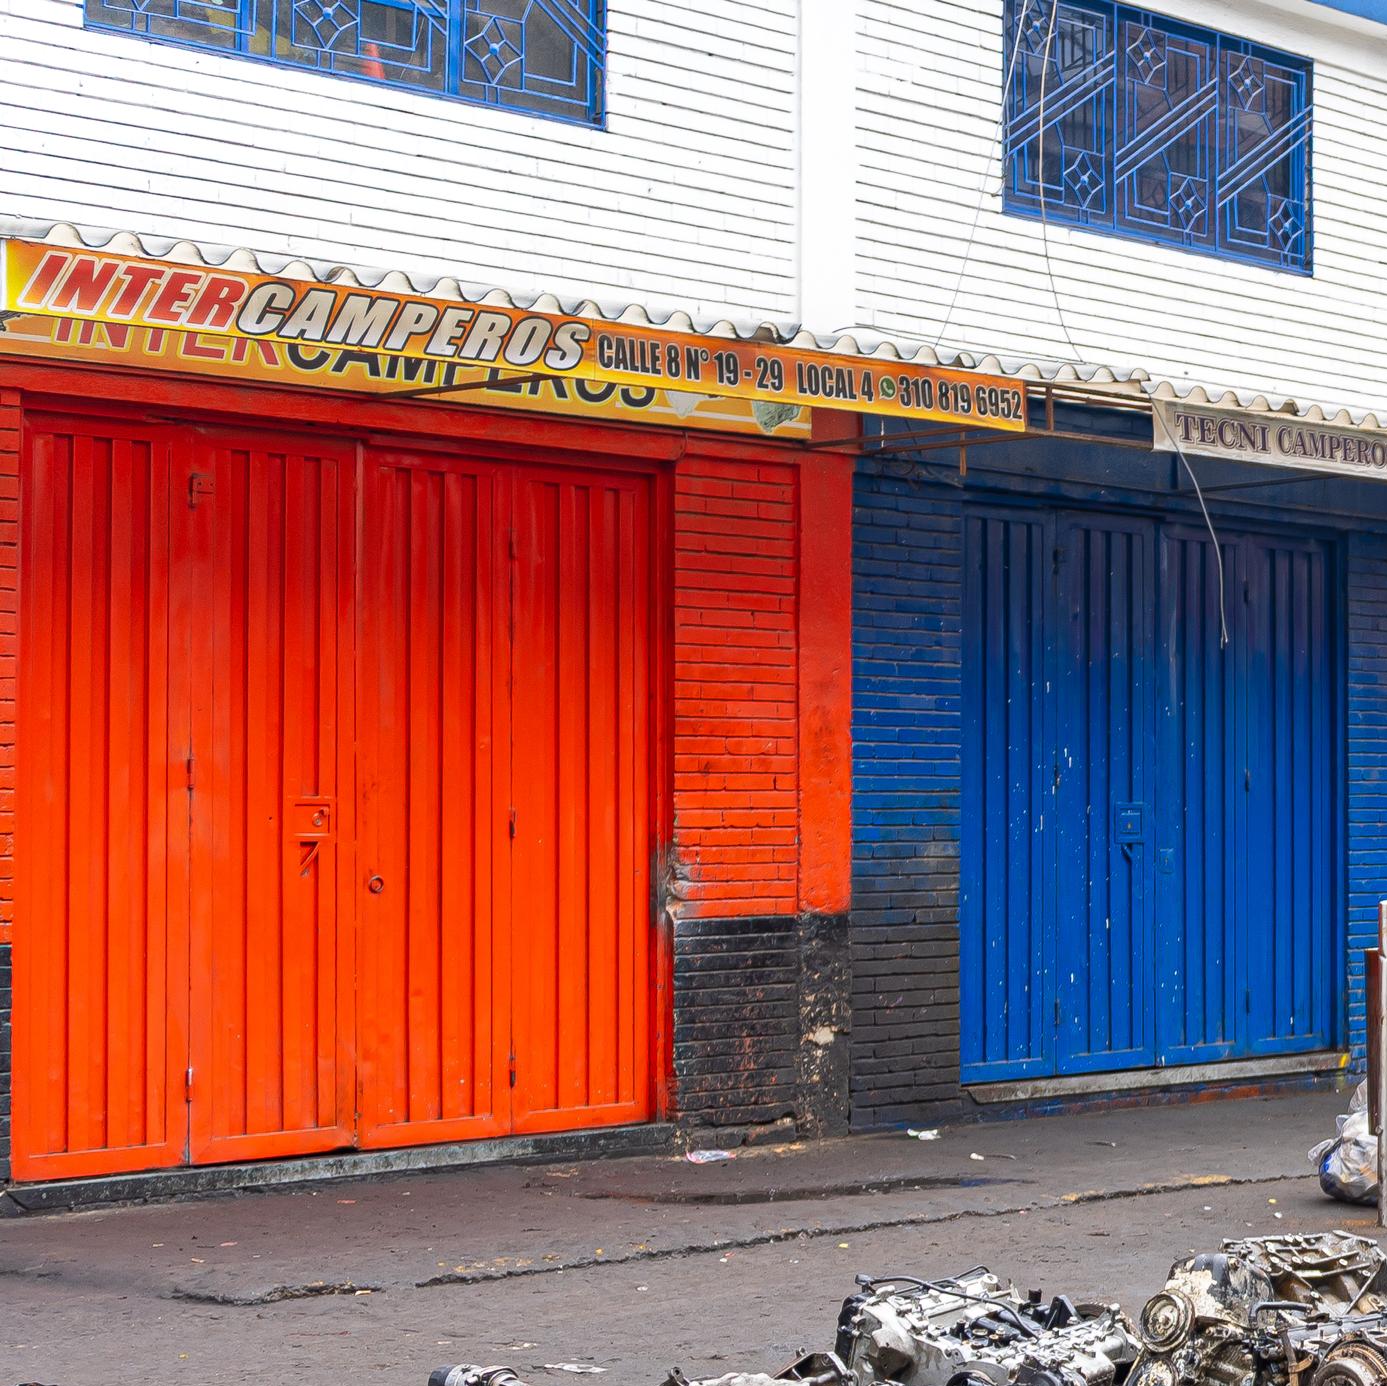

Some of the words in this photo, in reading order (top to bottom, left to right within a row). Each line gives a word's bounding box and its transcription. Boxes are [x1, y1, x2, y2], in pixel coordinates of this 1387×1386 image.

[598, 334, 661, 374] CALLE
[667, 345, 680, 378] 8
[714, 352, 739, 386] 19
[756, 357, 784, 391] 29
[797, 362, 857, 400] LOCAL
[861, 371, 874, 402] 4
[898, 376, 934, 410] 310
[938, 379, 972, 414] 819
[976, 385, 1023, 420] 6952
[1174, 412, 1270, 453] TECNI
